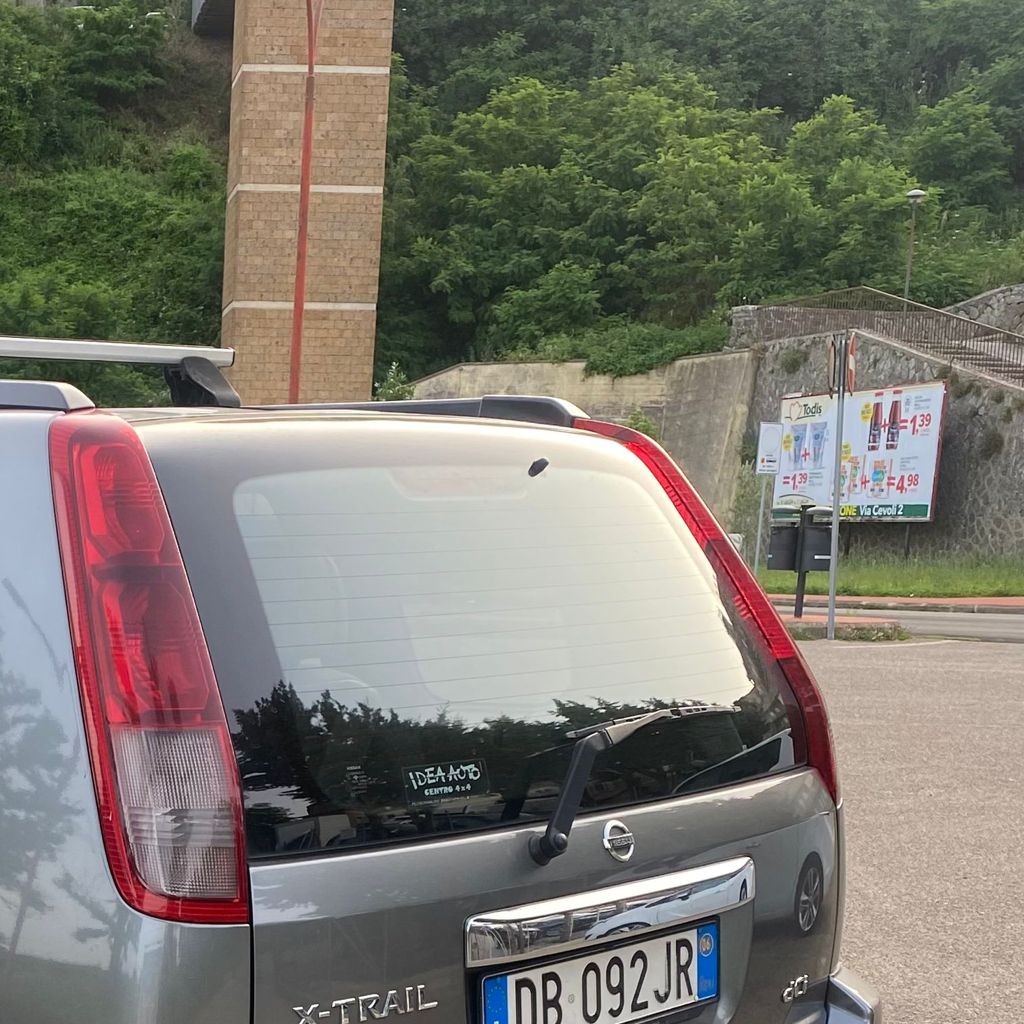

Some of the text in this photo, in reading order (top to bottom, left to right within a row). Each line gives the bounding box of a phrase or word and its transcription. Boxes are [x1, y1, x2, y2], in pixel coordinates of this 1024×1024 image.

[803, 403, 822, 415] Todis
[859, 504, 872, 516] Via
[872, 504, 897, 516] Cevoli
[897, 504, 904, 515] 2
[408, 764, 481, 789] IDEA AUTO
[424, 786, 454, 796] CENTRO
